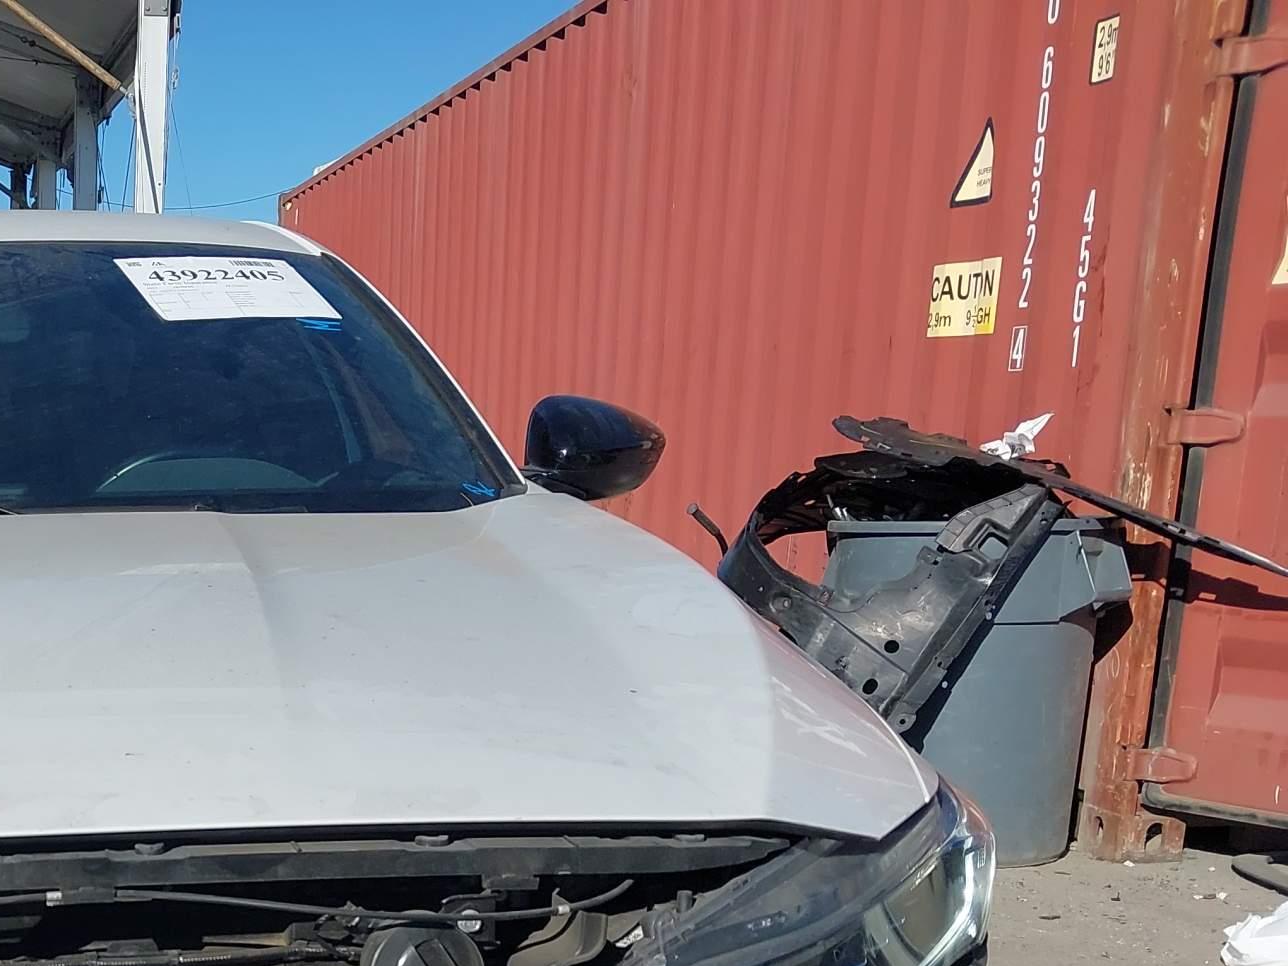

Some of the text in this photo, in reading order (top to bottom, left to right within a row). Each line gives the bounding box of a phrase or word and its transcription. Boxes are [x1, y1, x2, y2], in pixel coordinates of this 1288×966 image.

[1018, 45, 1055, 309] 609322
[148, 269, 285, 282] 43922405
[1011, 328, 1025, 370] 4
